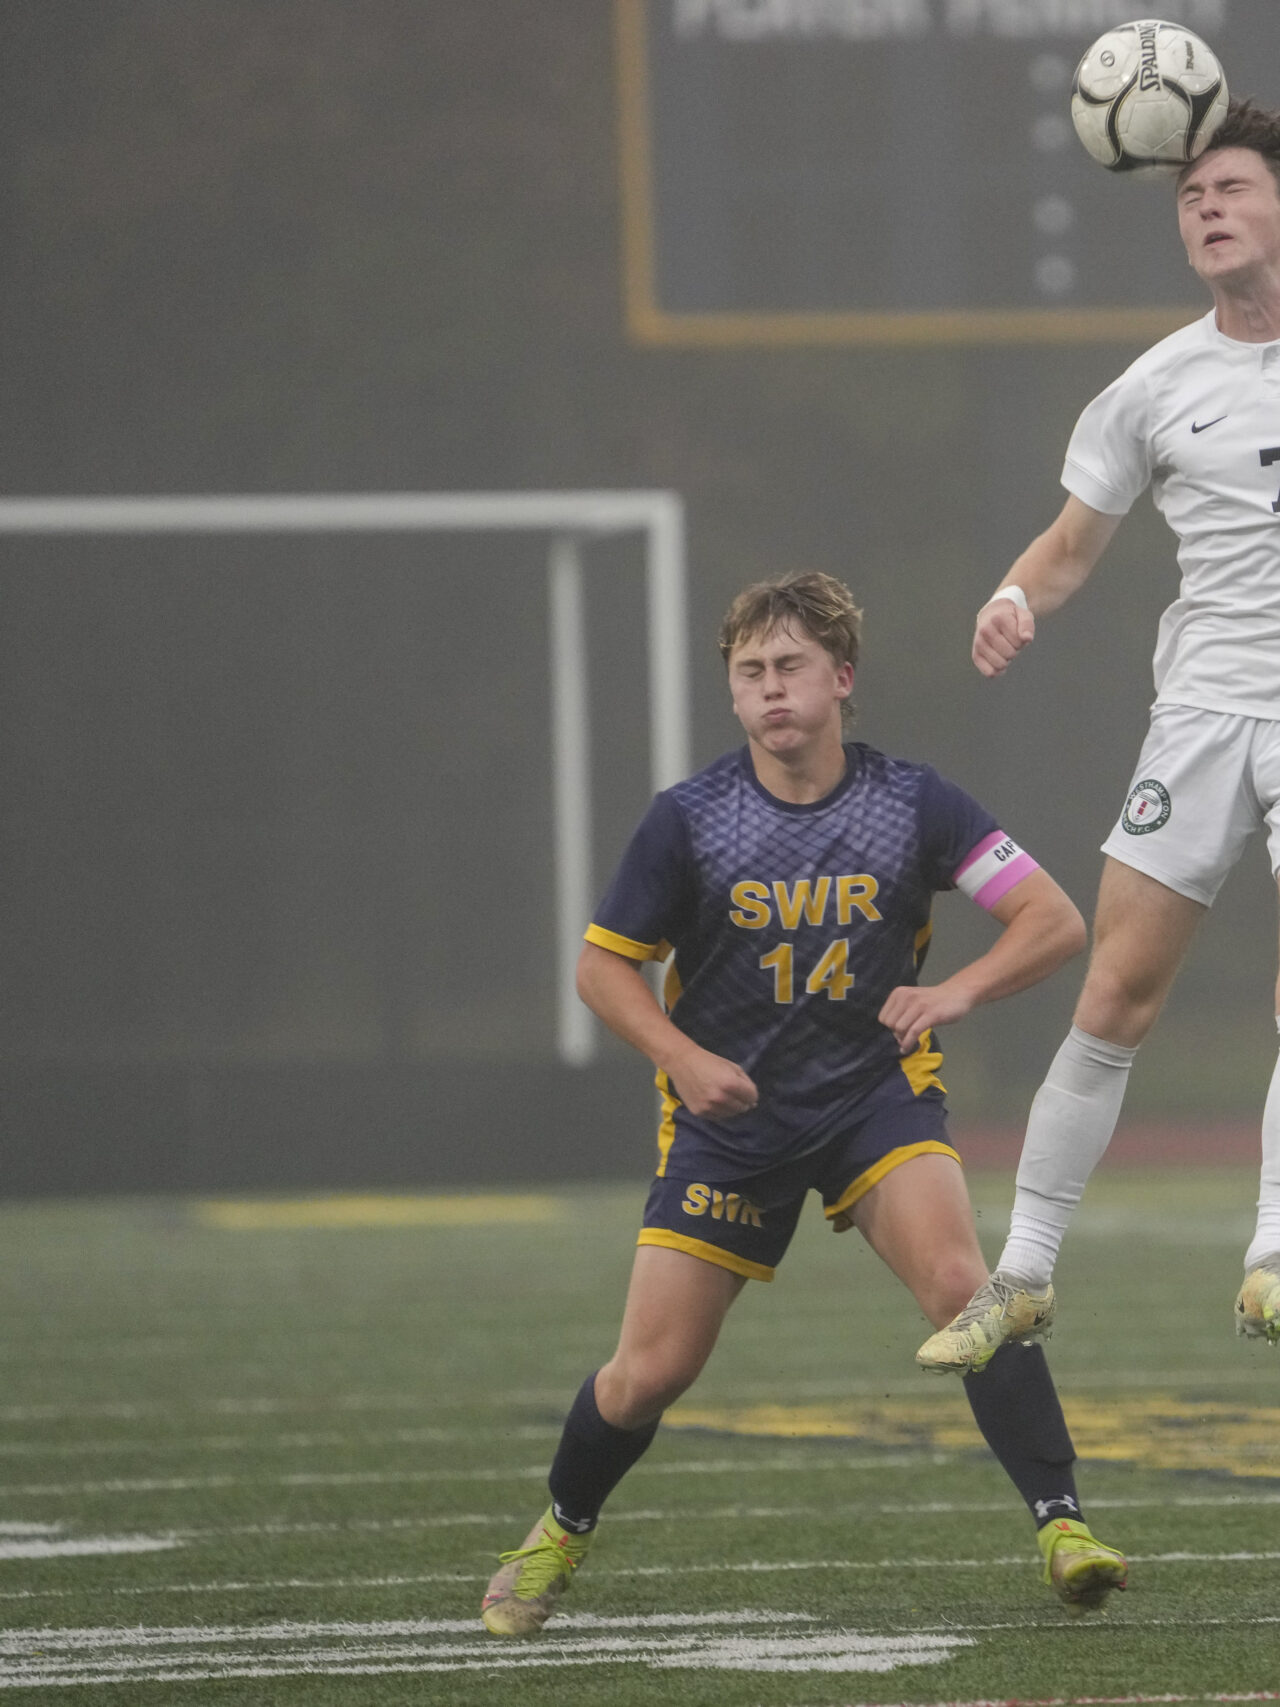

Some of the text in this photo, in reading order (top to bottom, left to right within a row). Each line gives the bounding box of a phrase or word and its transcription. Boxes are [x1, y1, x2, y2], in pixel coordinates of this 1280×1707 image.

[1139, 22, 1161, 91] SPALDING
[993, 839, 1017, 861] CAP
[729, 873, 883, 930] SWR
[760, 938, 855, 1004] 14
